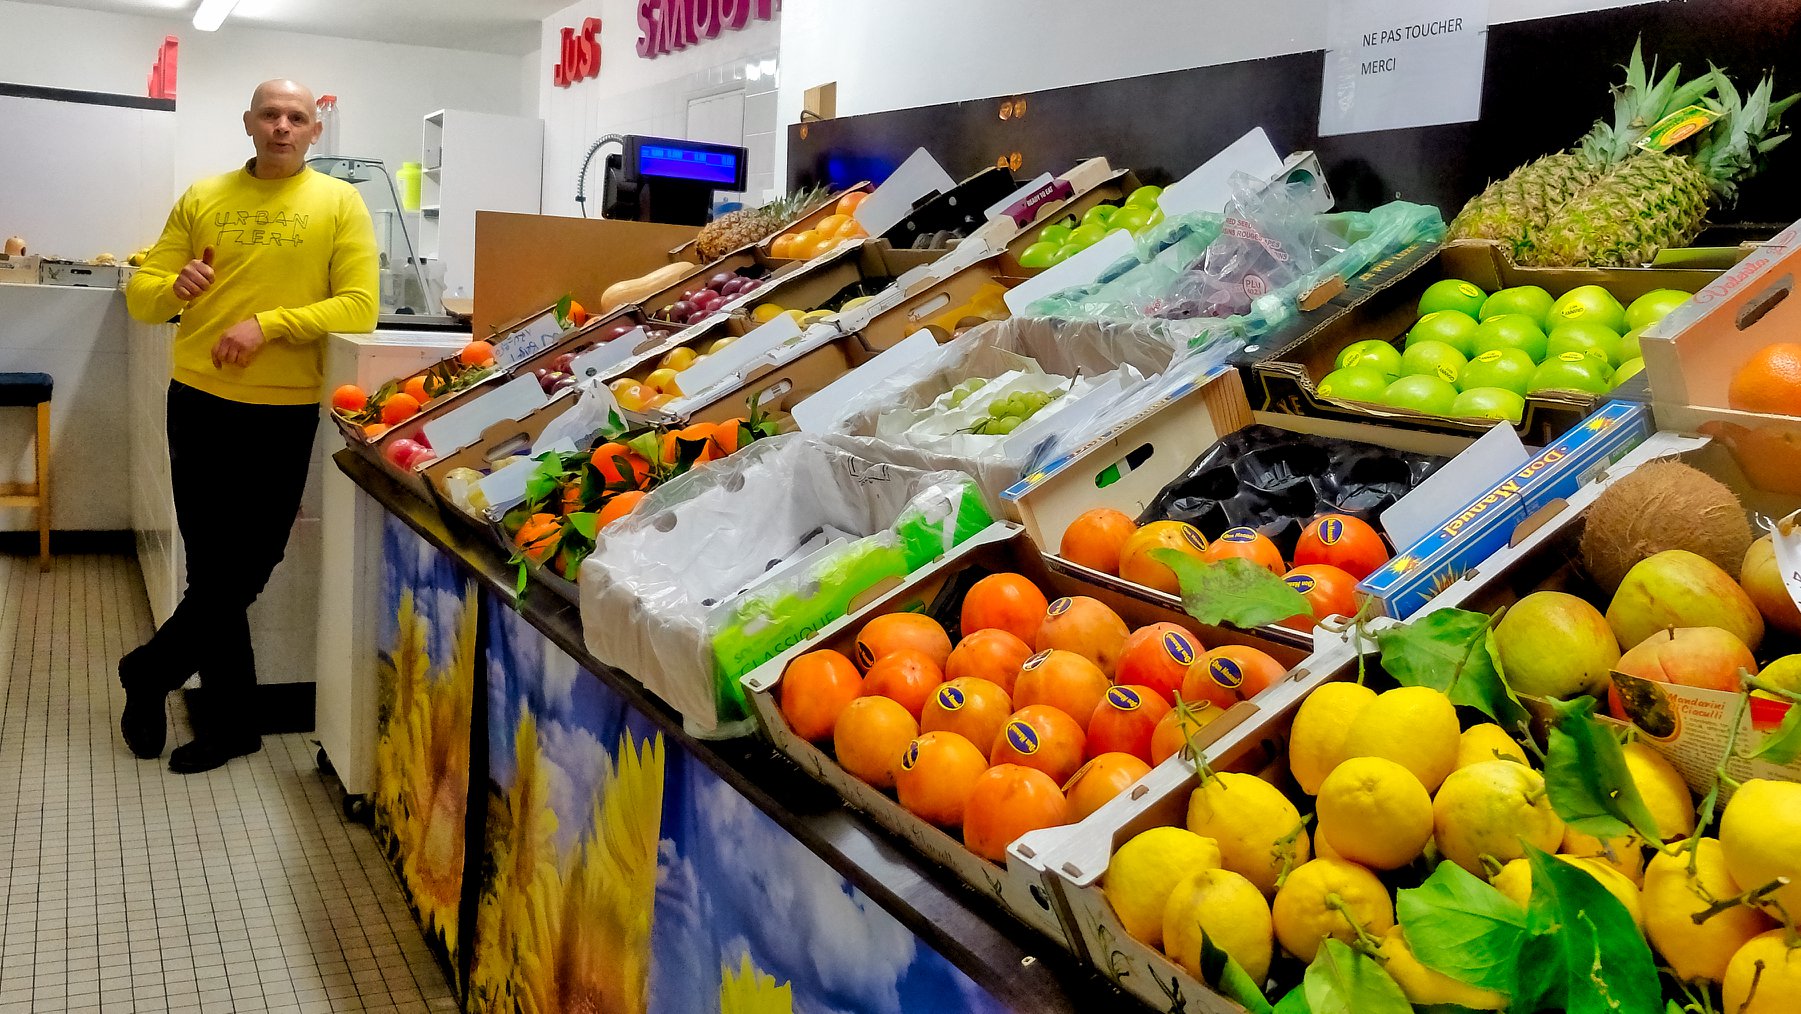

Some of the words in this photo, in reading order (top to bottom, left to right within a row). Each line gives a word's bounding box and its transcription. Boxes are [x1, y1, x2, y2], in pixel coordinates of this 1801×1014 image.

[635, 0, 782, 60] SMOO
[1362, 32, 1378, 47] NE
[1380, 28, 1402, 44] PAS
[1405, 17, 1463, 40] TOUCHER
[554, 17, 602, 88] JUS
[1361, 57, 1396, 76] MERCI
[215, 210, 309, 229] URBAN
[1245, 279, 1261, 289] PLU
[1517, 449, 1566, 480] Don
[1442, 480, 1523, 538] Manuel
[1667, 692, 1726, 710] Mandarini
